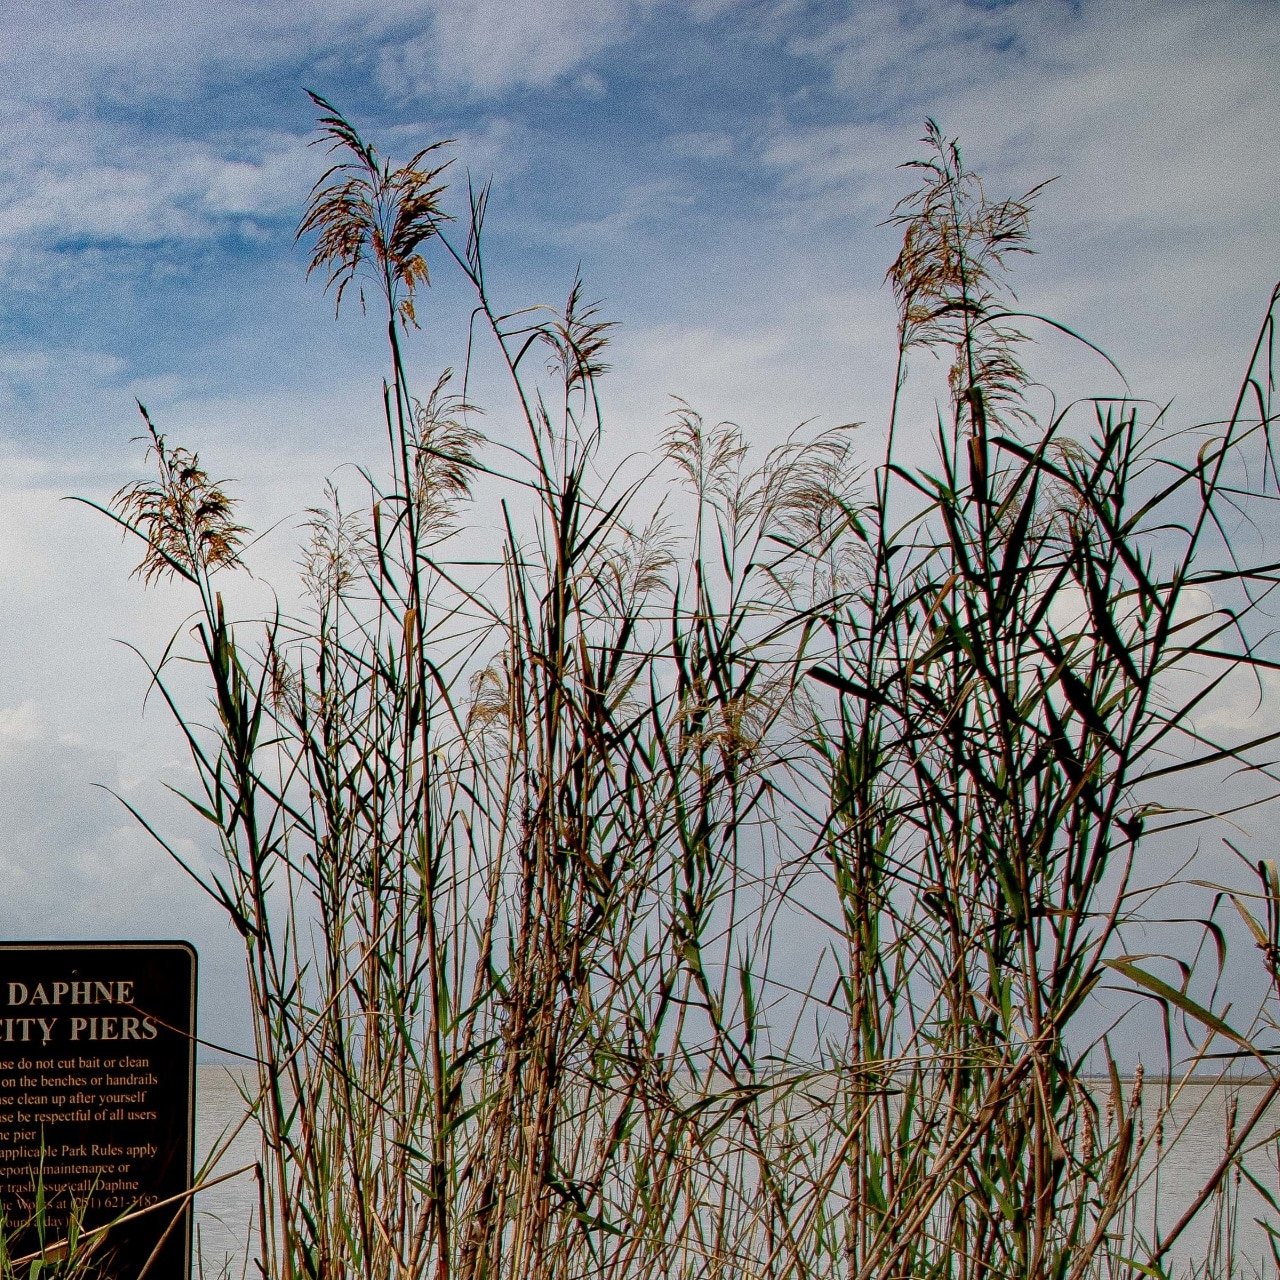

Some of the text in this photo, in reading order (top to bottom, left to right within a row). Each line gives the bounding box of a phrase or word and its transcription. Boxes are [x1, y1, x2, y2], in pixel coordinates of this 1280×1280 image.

[7, 981, 134, 1006] DAPHNE
[69, 1016, 158, 1041] PIERS
[17, 1057, 32, 1070] do
[36, 1058, 54, 1069] not
[57, 1058, 76, 1069] cut
[78, 1056, 100, 1068] bait
[103, 1059, 117, 1068] or
[119, 1055, 149, 1068] clean
[1, 1079, 16, 1087] on
[20, 1075, 38, 1087] the
[41, 1074, 87, 1087] benches
[90, 1077, 103, 1086] or
[106, 1073, 158, 1086] handrails
[17, 1092, 48, 1105] clean
[51, 1095, 66, 1107] up
[69, 1092, 96, 1104] after
[99, 1091, 148, 1106] yourself
[17, 1110, 31, 1122] be
[34, 1109, 91, 1125] respectful
[94, 1108, 109, 1121] of
[109, 1109, 124, 1120] all
[127, 1111, 157, 1120] users
[13, 1128, 37, 1143] pier
[61, 1145, 87, 1157] Park
[91, 1144, 123, 1156] Rules
[126, 1143, 158, 1158] apply
[32, 1167, 39, 1175] a
[43, 1162, 115, 1175] maintenance
[118, 1164, 131, 1173] or
[7, 1181, 35, 1193] trash
[41, 1181, 67, 1192] ssue
[71, 1179, 91, 1191] call
[95, 1178, 139, 1193] Daphne
[56, 1199, 67, 1209] at
